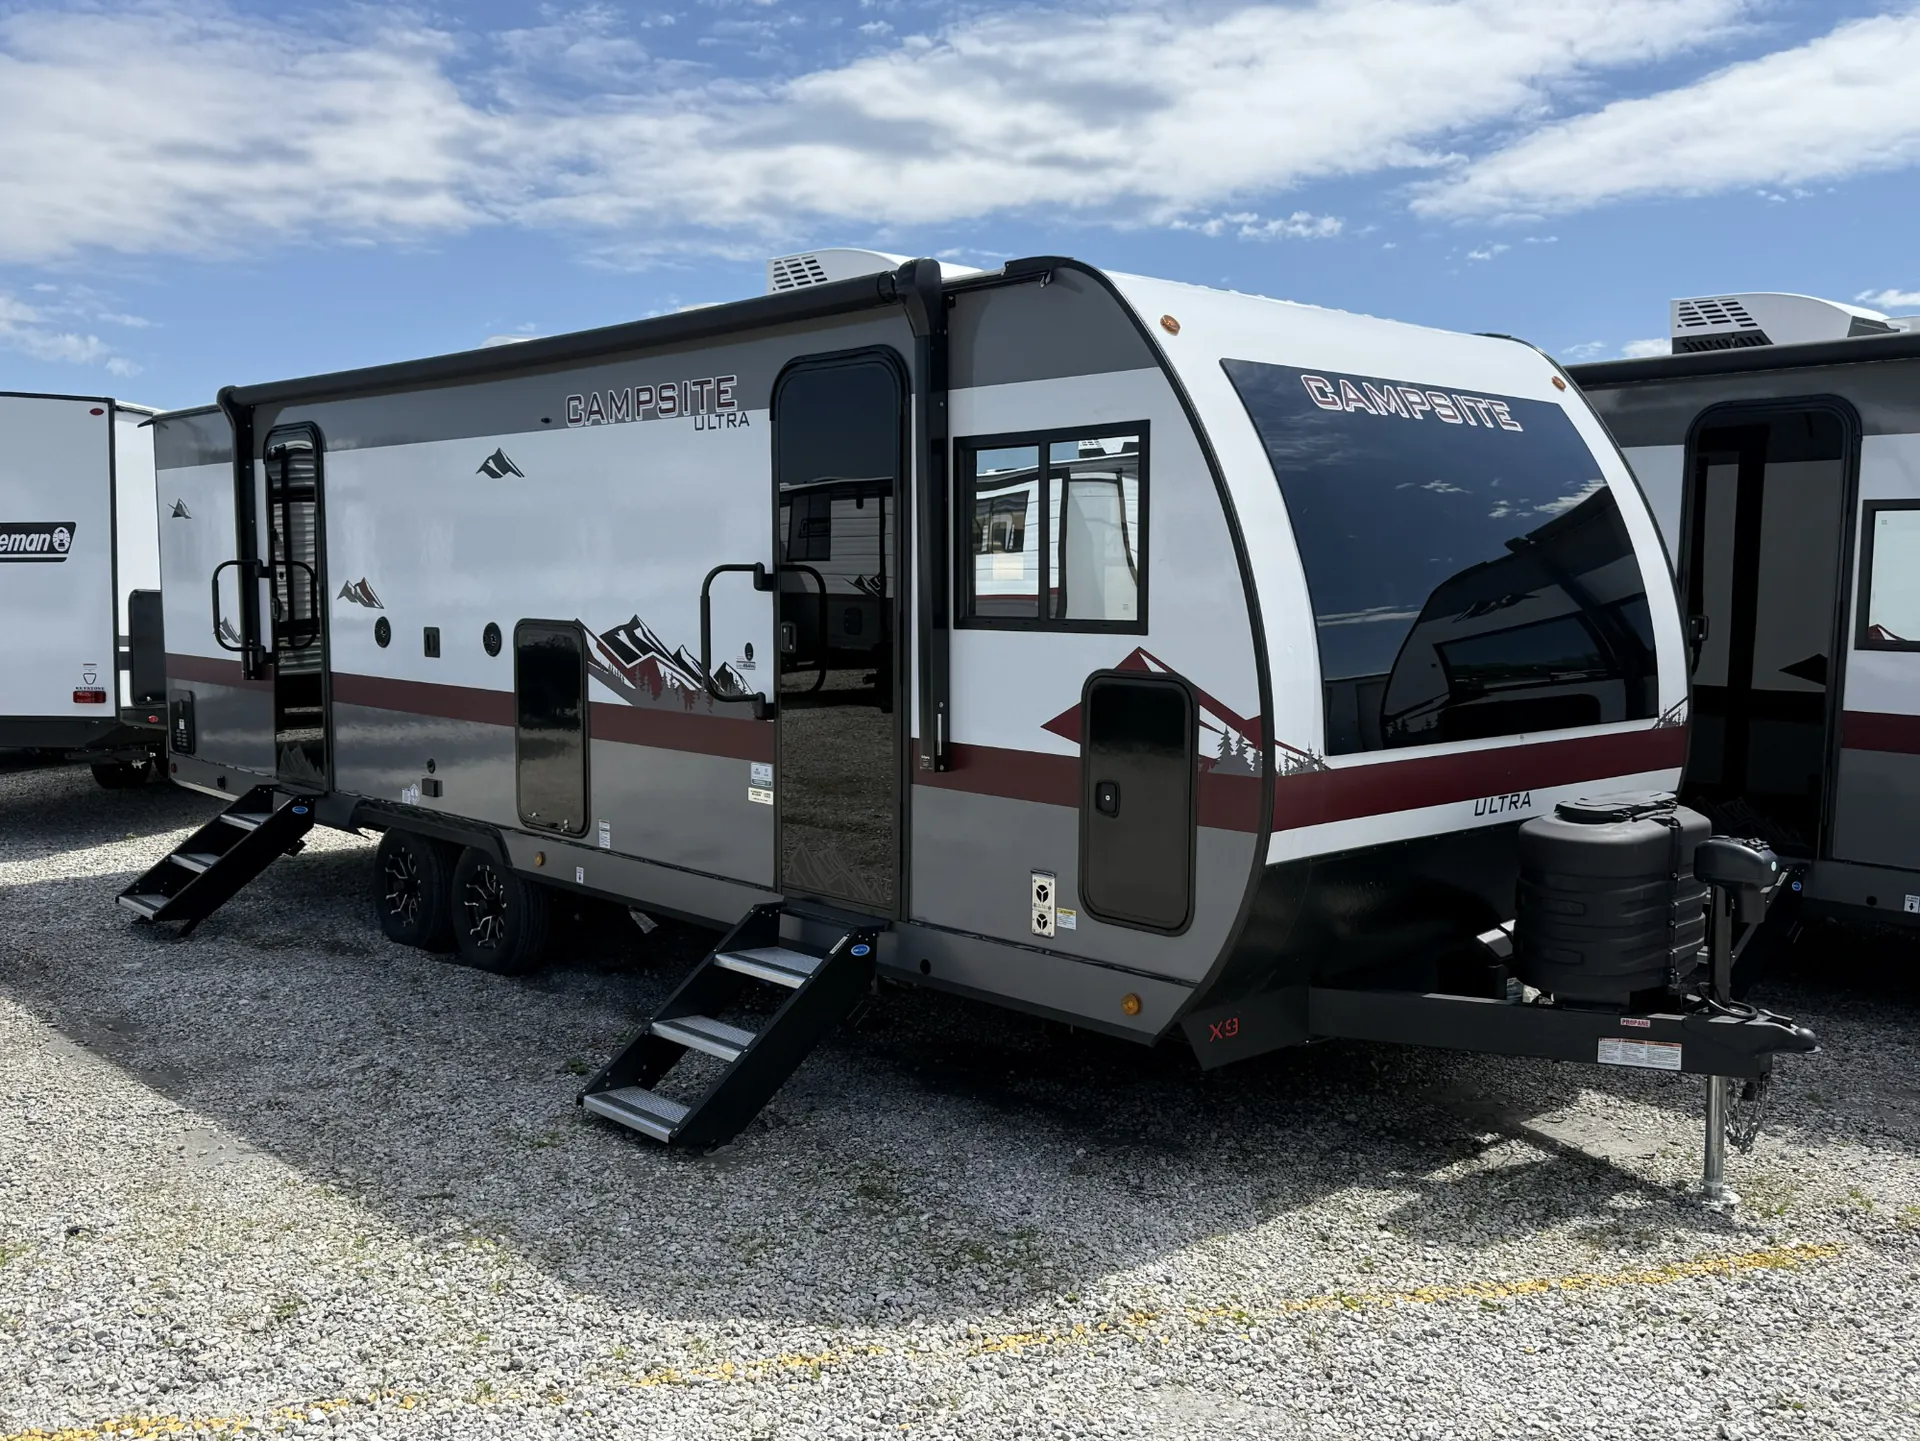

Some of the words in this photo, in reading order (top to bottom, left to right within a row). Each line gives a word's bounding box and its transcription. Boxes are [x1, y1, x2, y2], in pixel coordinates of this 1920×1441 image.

[566, 375, 738, 428] CAMPSITE
[1301, 375, 1523, 432] CAMPSITE
[694, 411, 750, 431] ULTRA
[1474, 791, 1531, 817] ULTRA
[1209, 1017, 1239, 1042] X9
[1621, 1018, 1650, 1028] PROPANE
